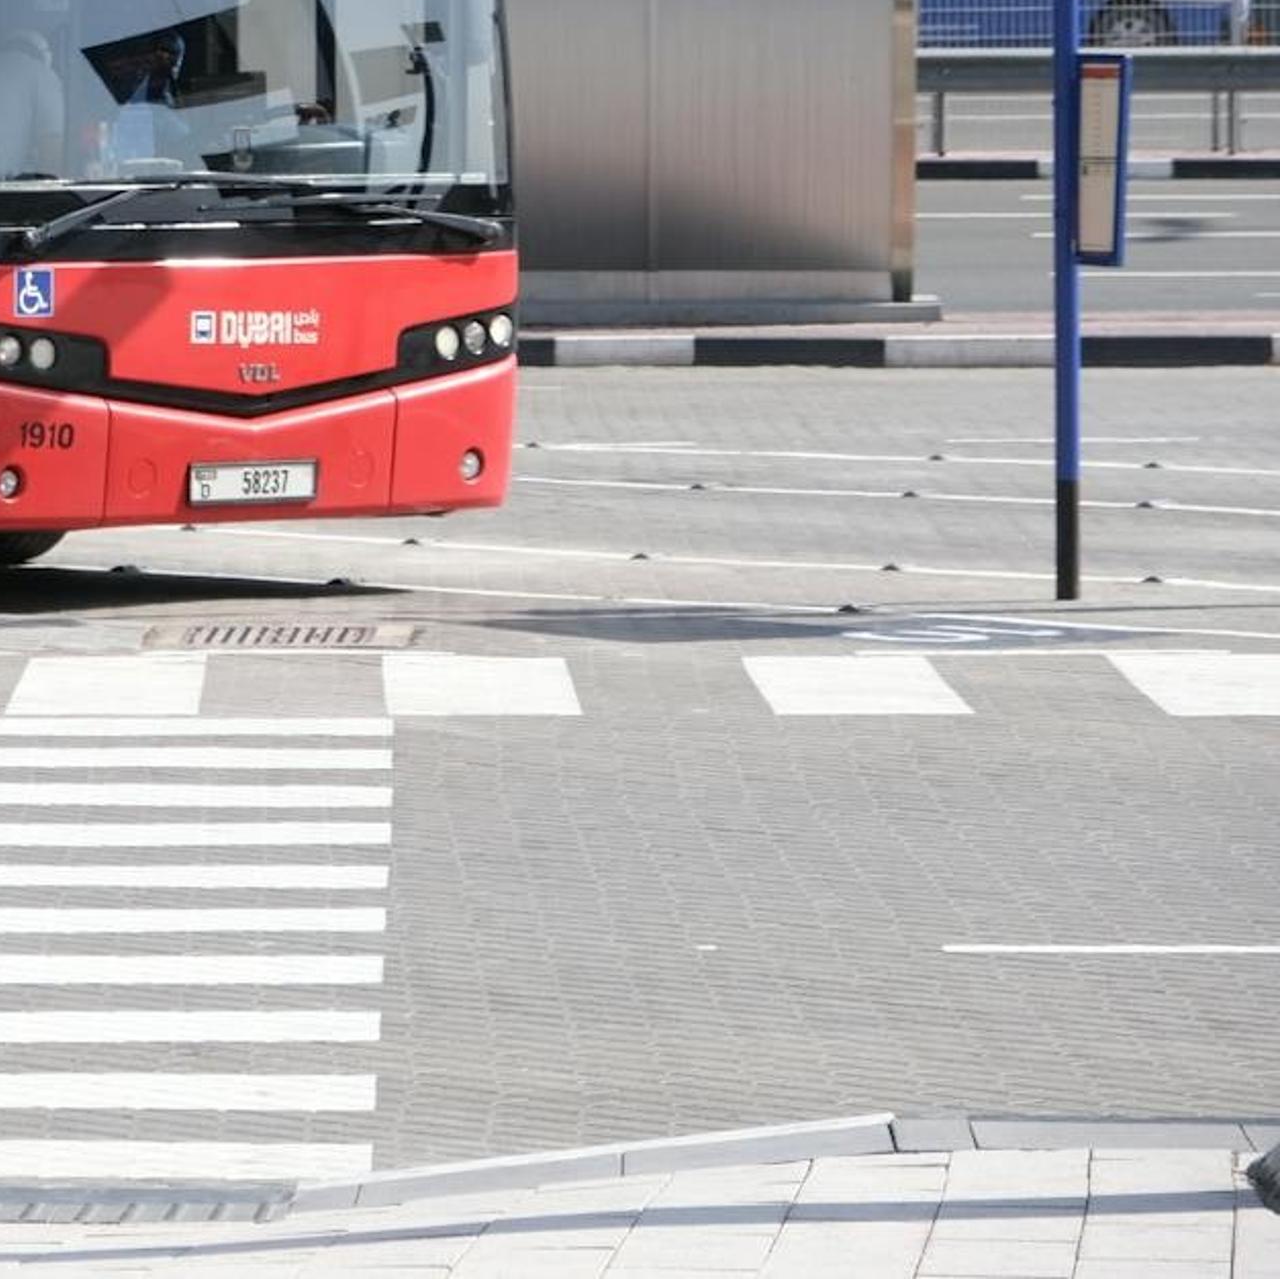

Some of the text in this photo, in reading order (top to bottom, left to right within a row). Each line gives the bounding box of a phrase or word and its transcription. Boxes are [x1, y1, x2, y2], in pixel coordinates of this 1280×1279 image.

[221, 311, 292, 348] DUBAI
[20, 422, 75, 449] 1910
[242, 470, 289, 495] 58237
